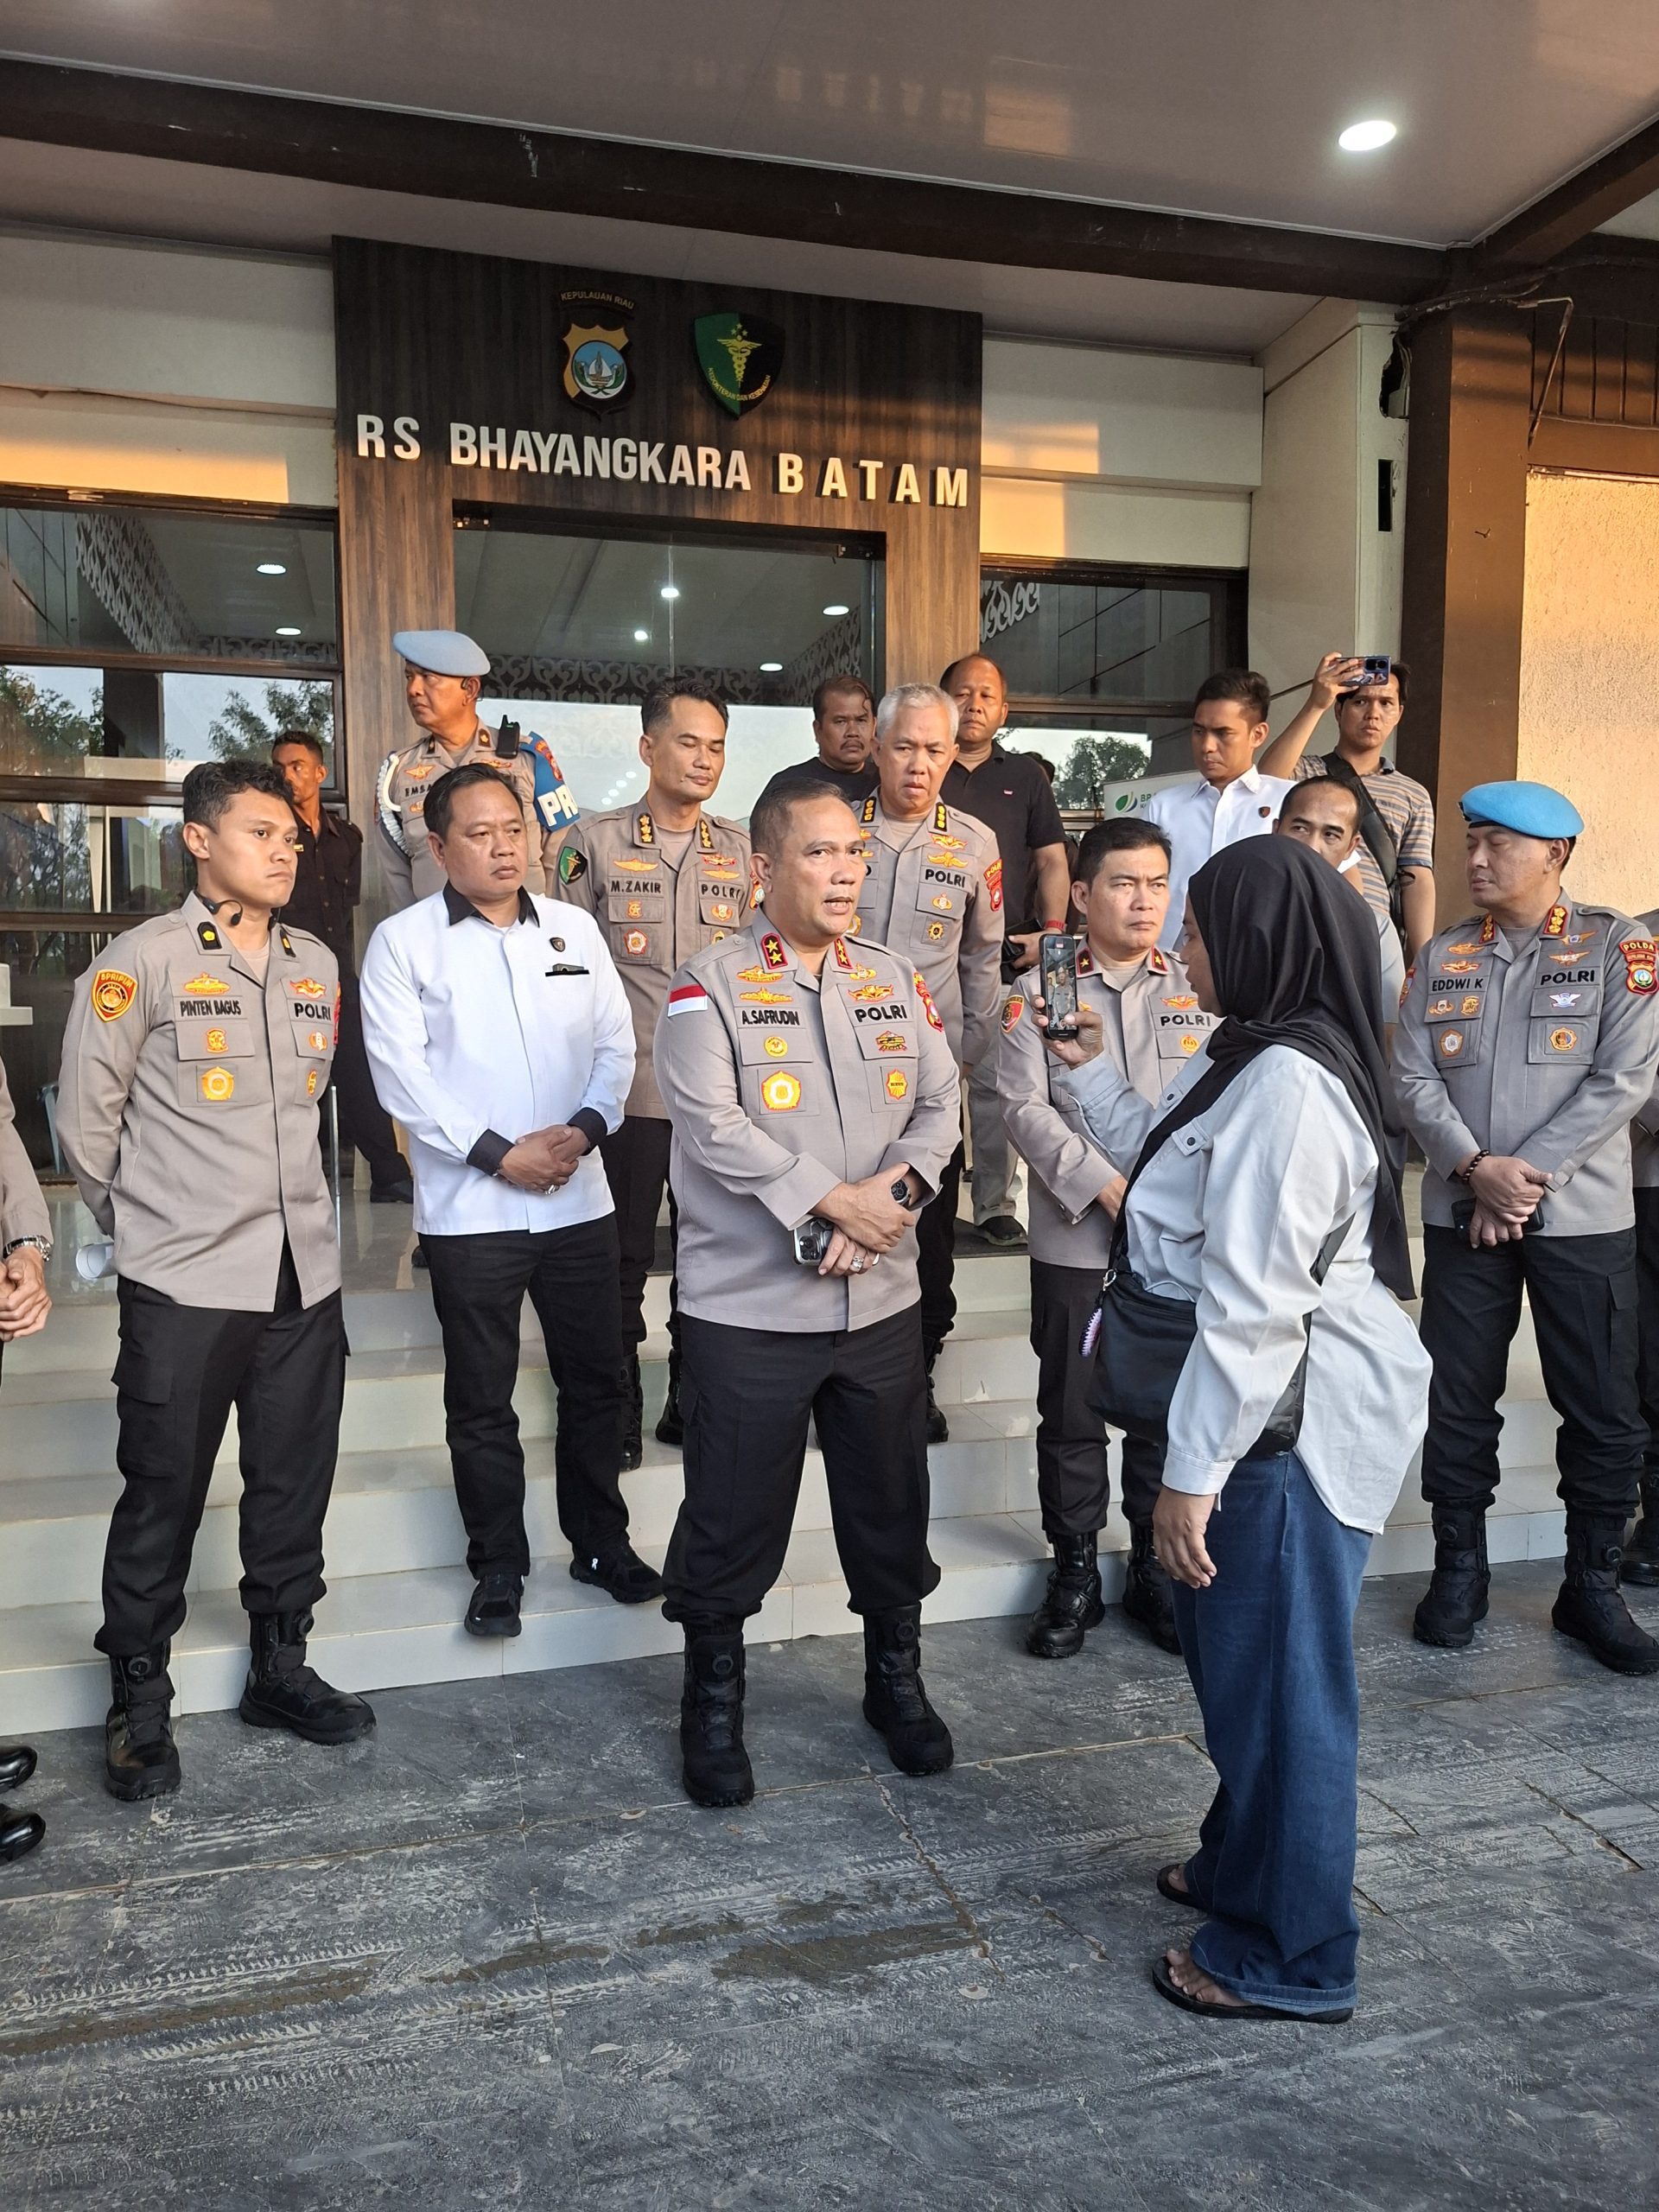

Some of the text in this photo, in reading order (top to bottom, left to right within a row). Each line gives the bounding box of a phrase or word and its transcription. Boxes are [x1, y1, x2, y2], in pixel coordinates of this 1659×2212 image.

[560, 290, 635, 309] KEPULAUAN RIAU
[357, 414, 968, 507] RS BHAYANGKARA BATAM
[610, 880, 662, 893] M.ZAKIR
[925, 868, 966, 888] POLRI
[701, 883, 741, 899] POLRI
[1623, 941, 1655, 951] POLDA
[1432, 977, 1484, 992] EDDWI K
[1540, 969, 1595, 986] POLRI
[180, 1000, 242, 1017] PINTEN BAGUS
[294, 1002, 332, 1020] POLRI
[855, 1004, 907, 1023] POLRI
[741, 1009, 800, 1026] A.SAFRUDIN
[1160, 1014, 1211, 1027] POLRI
